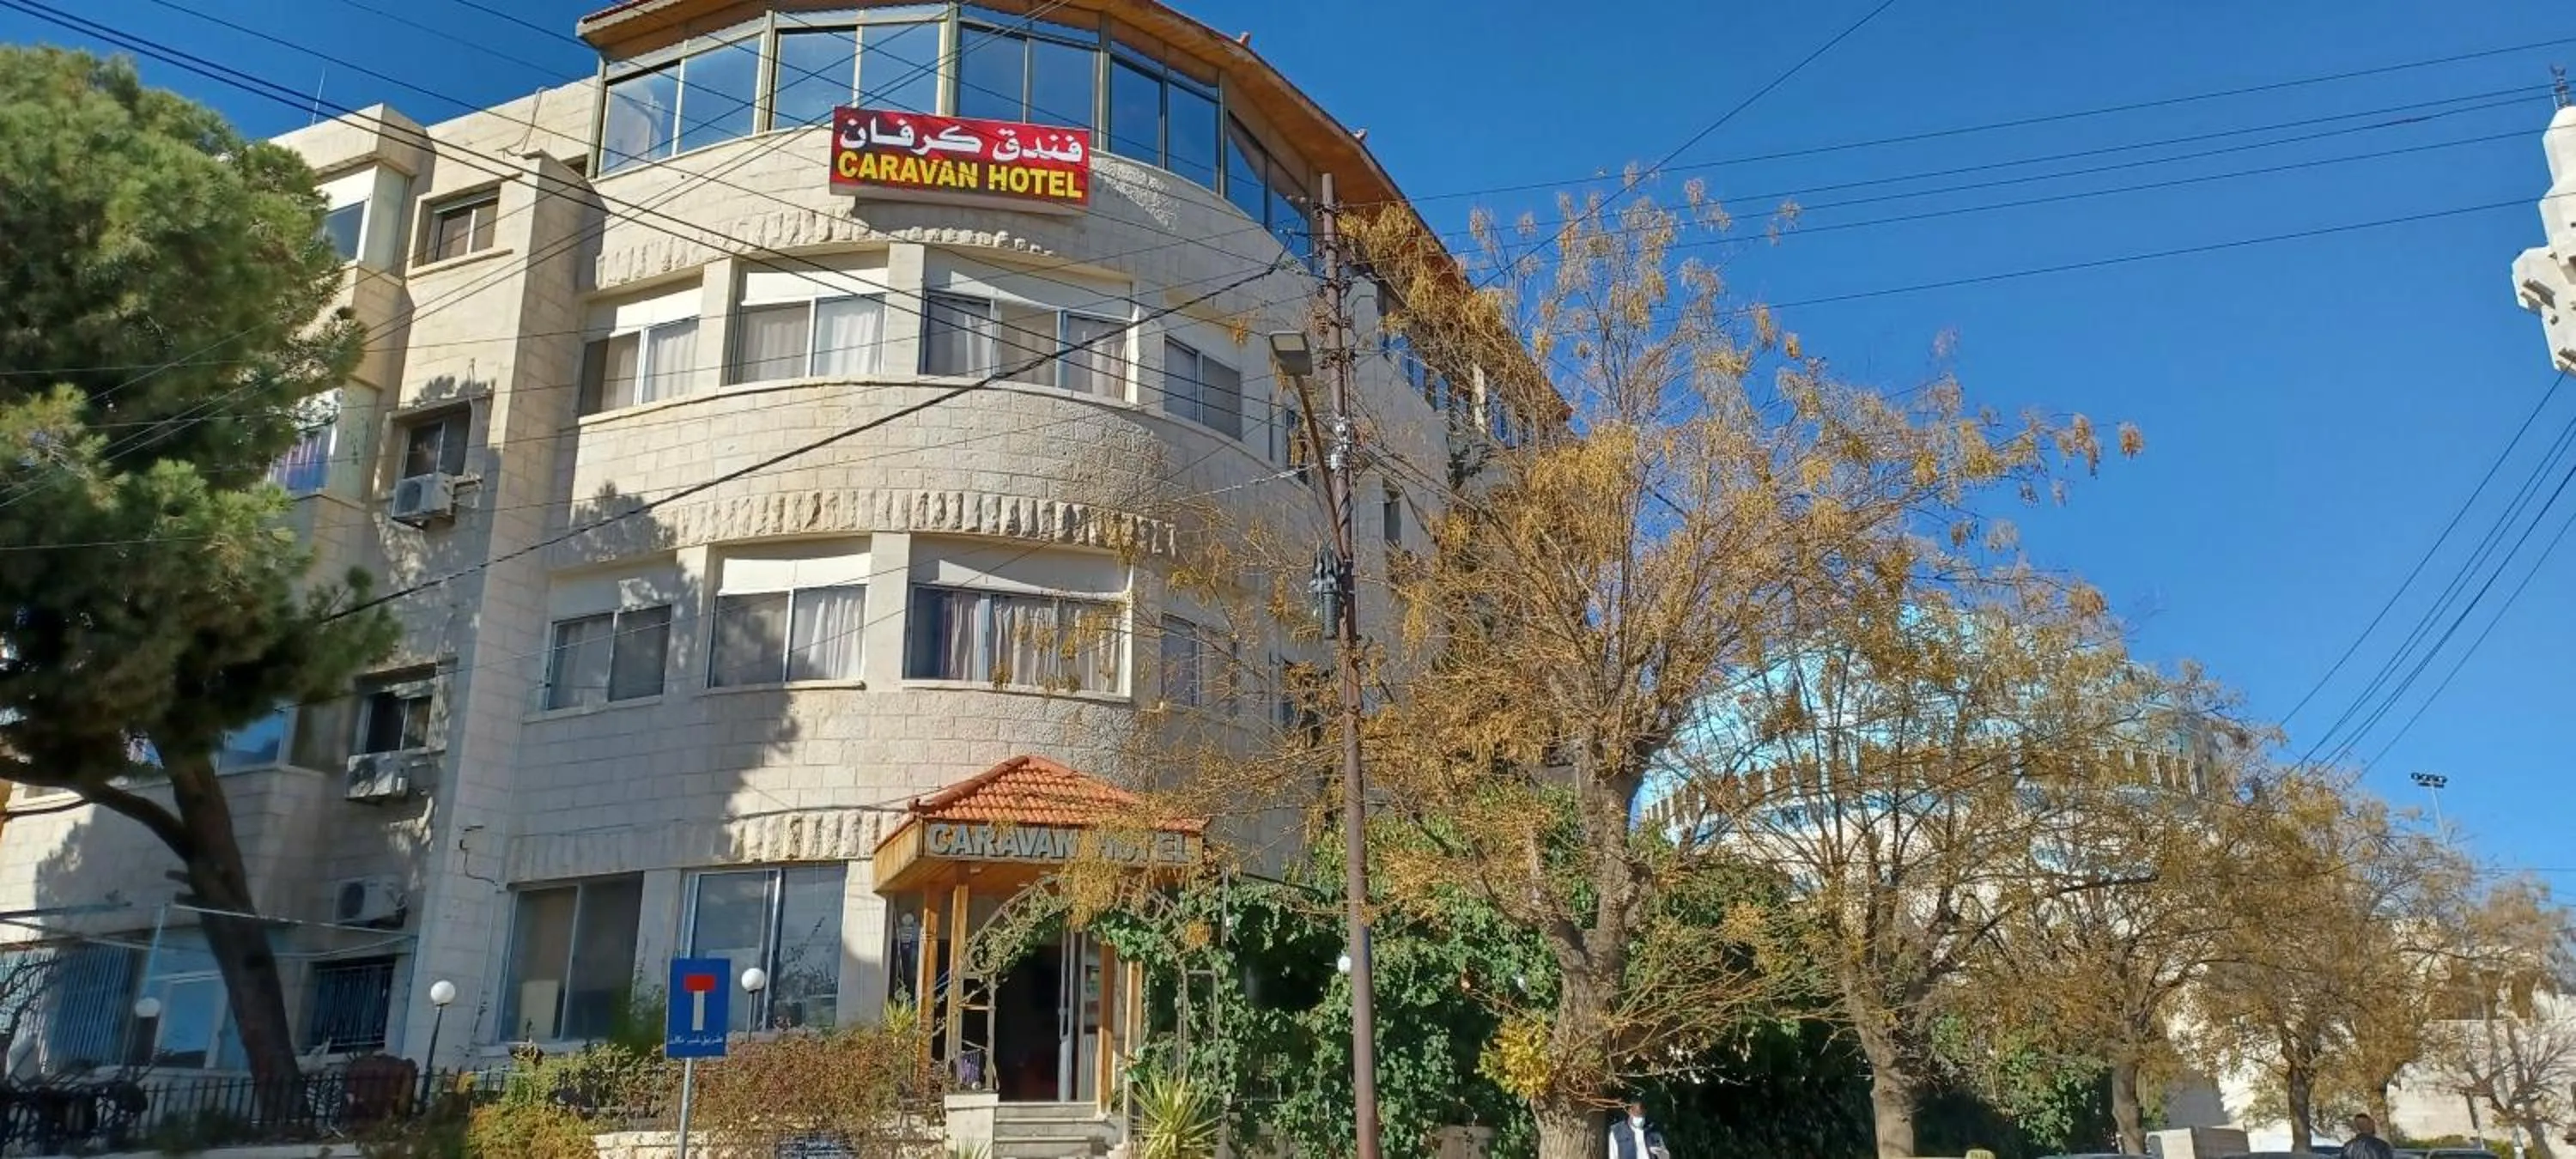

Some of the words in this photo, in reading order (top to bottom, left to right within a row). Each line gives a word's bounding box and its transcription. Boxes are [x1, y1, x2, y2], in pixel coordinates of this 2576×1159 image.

[839, 116, 983, 155] كرفان
[992, 128, 1083, 162] فندق
[838, 152, 978, 189] CARAVAN
[987, 164, 1083, 198] HOTEL
[927, 822, 1078, 859] CARAVAN
